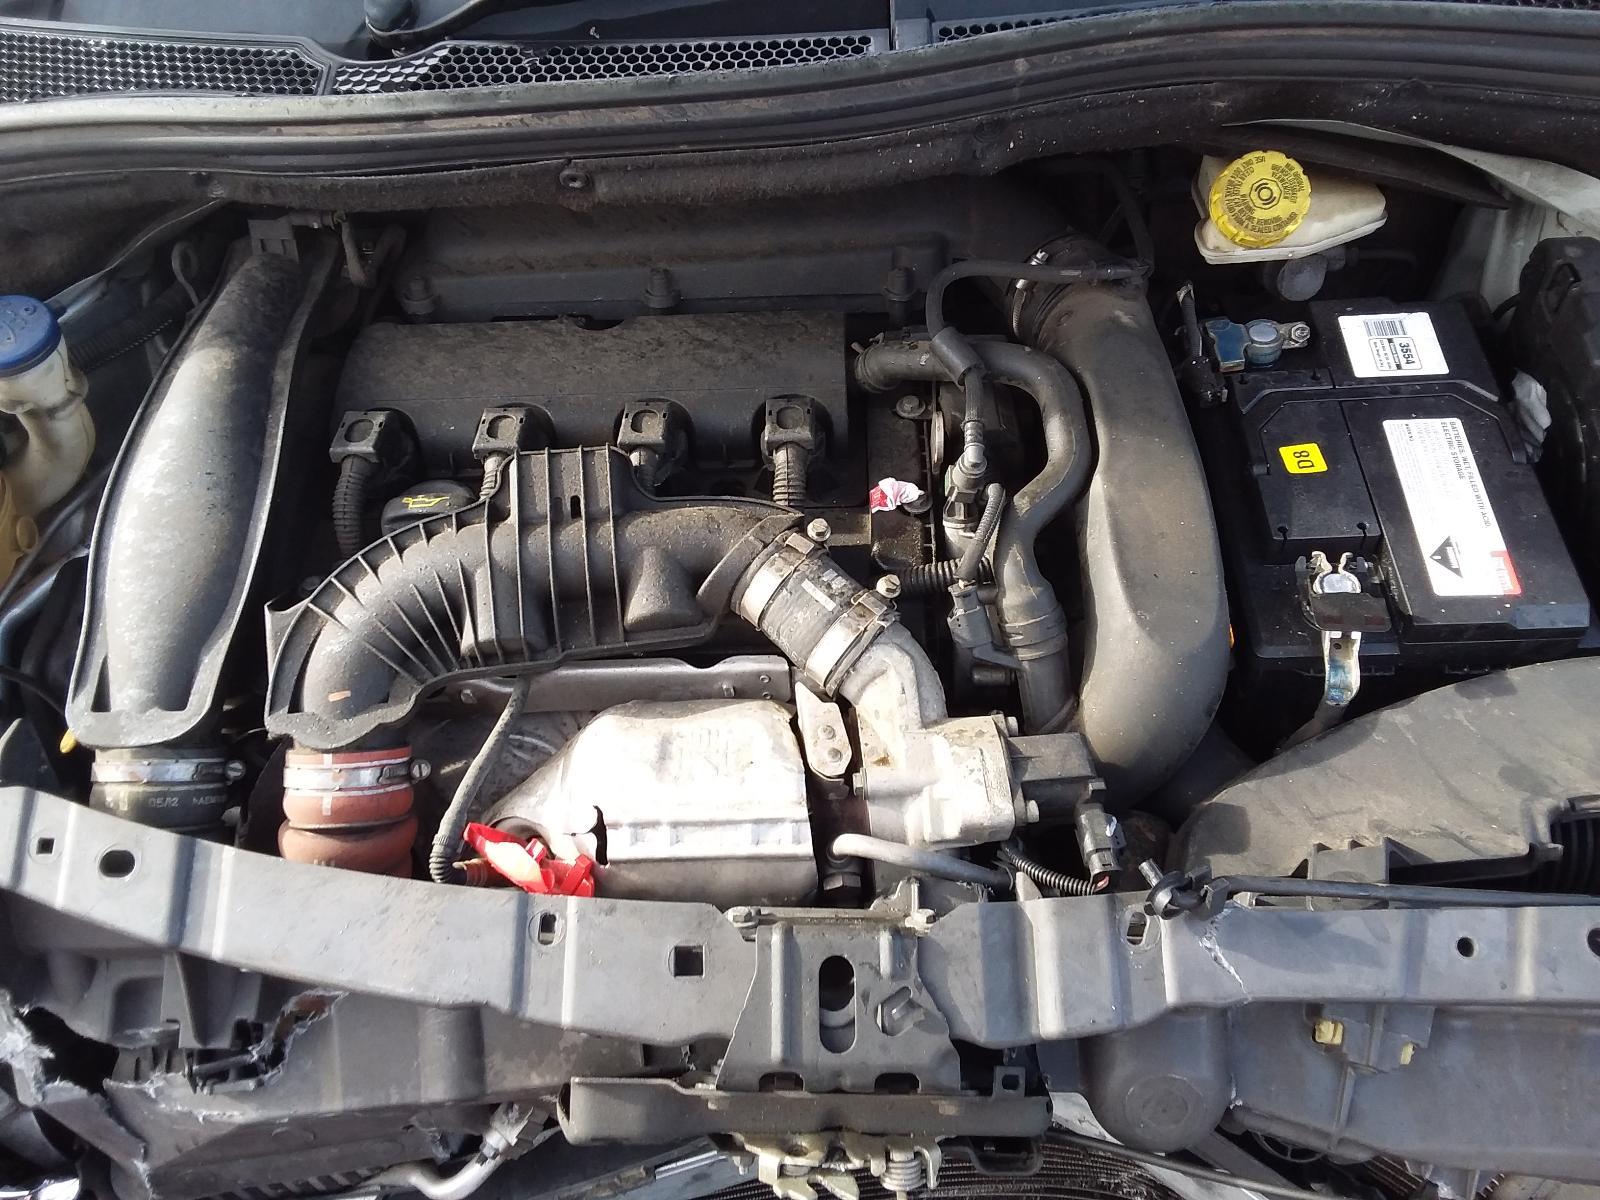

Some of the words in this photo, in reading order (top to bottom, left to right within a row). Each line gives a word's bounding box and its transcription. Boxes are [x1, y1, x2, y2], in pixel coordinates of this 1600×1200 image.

[1254, 155, 1265, 164] USE
[1239, 166, 1255, 182] CLEAN
[1257, 214, 1283, 226] REMOVING
[1250, 224, 1272, 233] SEALED
[1273, 211, 1298, 232] CONTAINER
[1399, 342, 1415, 364] 3554
[1451, 451, 1466, 480] STORAGE
